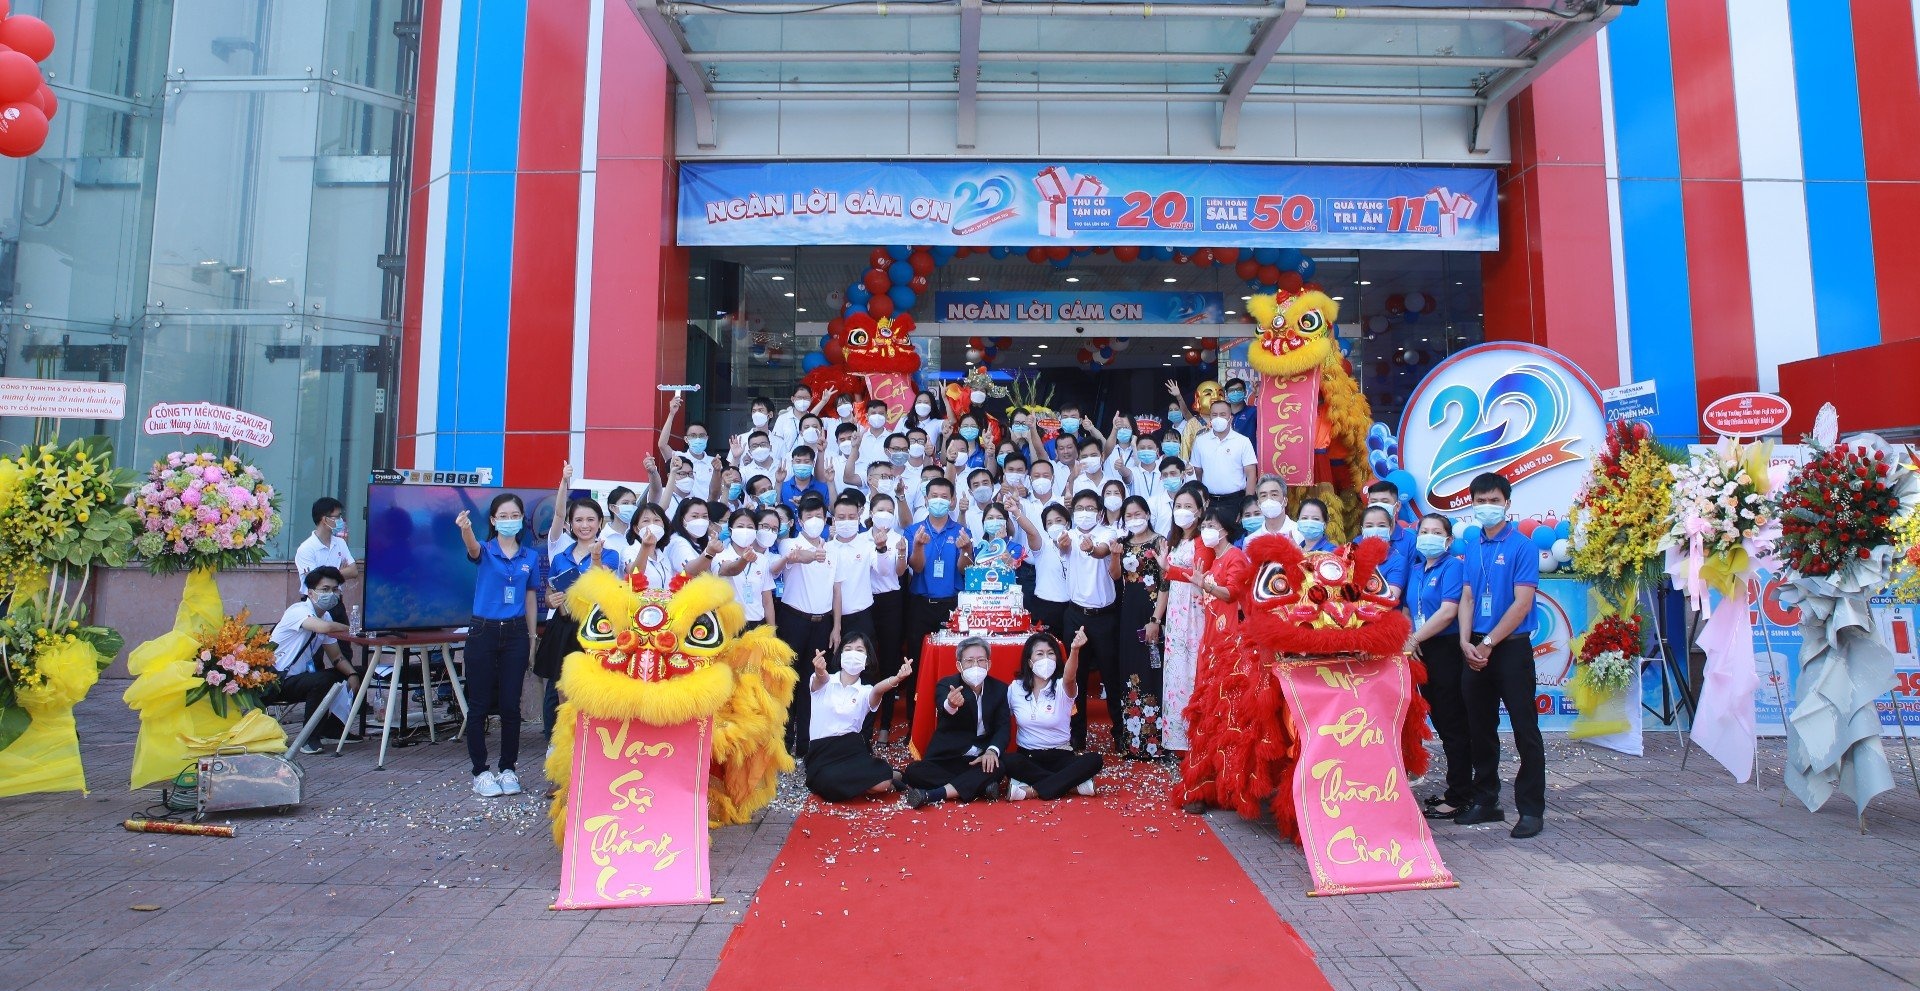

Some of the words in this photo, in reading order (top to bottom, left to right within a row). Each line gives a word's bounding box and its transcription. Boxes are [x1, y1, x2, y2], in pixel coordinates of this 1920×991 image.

[706, 193, 785, 224] NGÀN
[793, 188, 836, 215] LỜI
[845, 188, 902, 217] CẢM
[909, 197, 951, 224] ƠN
[1093, 197, 1105, 206] CŨ
[1206, 198, 1223, 207] LIÊN
[1333, 200, 1355, 210] QUÀ
[1357, 201, 1384, 212] TẶNG
[1072, 207, 1090, 217] TẬN
[1116, 190, 1188, 229] 20
[1206, 207, 1248, 221] SALE
[1333, 213, 1357, 223] TRI
[1362, 210, 1383, 223] ÂN
[1387, 196, 1427, 232] 11
[1216, 221, 1238, 230] GIẢM
[948, 300, 1010, 322] NGÀN
[1016, 300, 1052, 322] LỜI
[1057, 300, 1105, 321] CẢM
[1109, 302, 1143, 321] ƠN
[1226, 368, 1262, 381] SAL
[155, 406, 180, 419] CÔNG
[182, 407, 192, 416] TY
[1607, 408, 1620, 421] 20
[149, 419, 167, 431] Chúc
[194, 419, 210, 430] Sinh
[258, 434, 270, 444] 20
[1514, 459, 1536, 476] SÁNG
[1536, 453, 1553, 466] TẠO
[1449, 494, 1464, 508] ĐỔI
[1536, 672, 1558, 687] ẢM
[595, 719, 675, 765] Vạn
[608, 769, 656, 814] Sự
[1311, 758, 1400, 819] Thành
[583, 814, 690, 872] Thắng
[1326, 825, 1421, 879] Công
